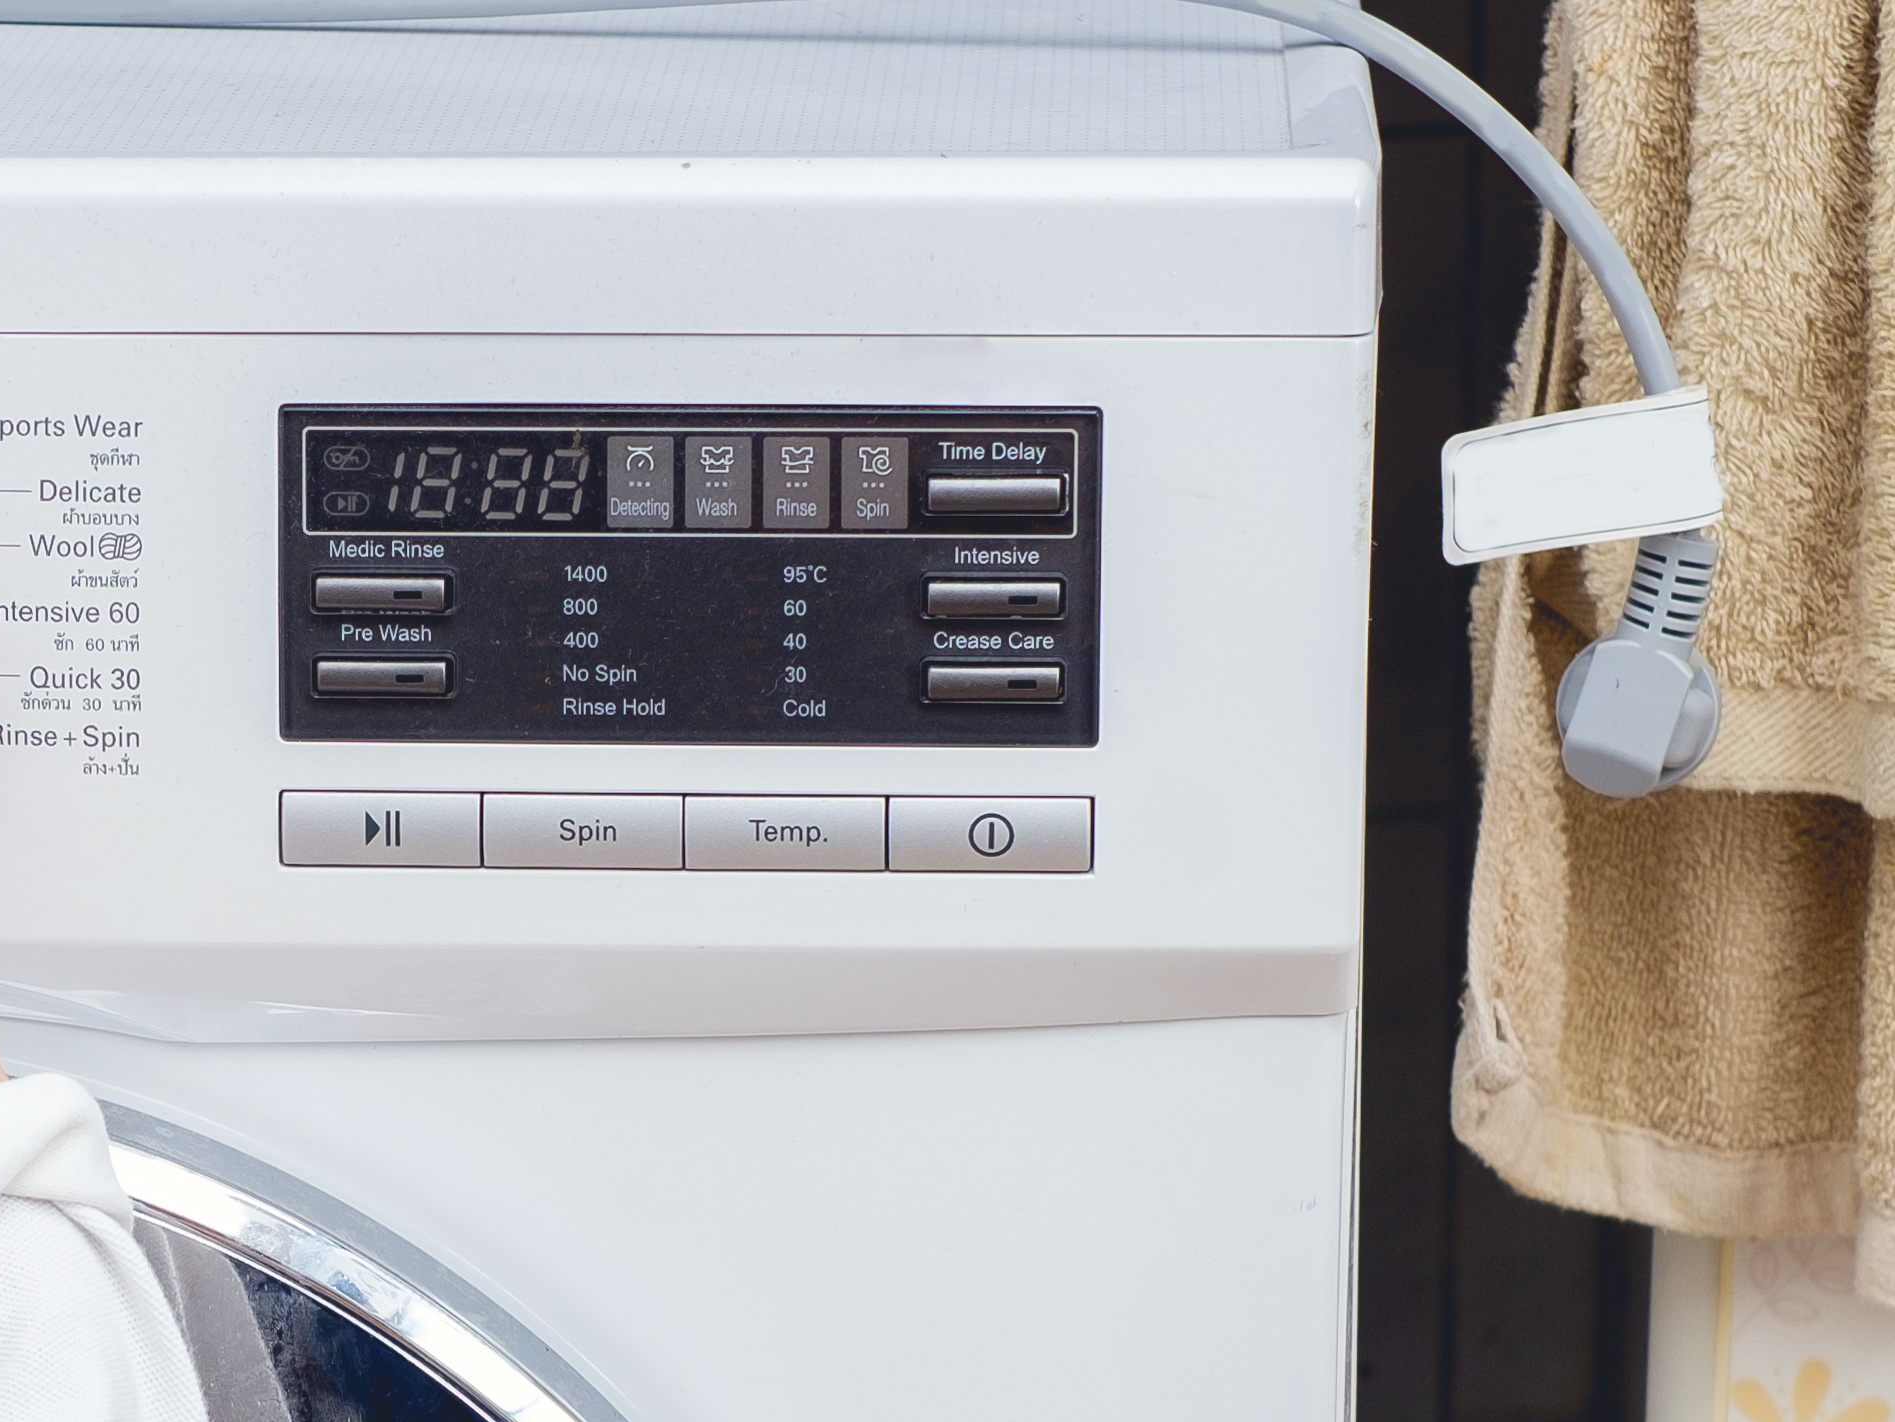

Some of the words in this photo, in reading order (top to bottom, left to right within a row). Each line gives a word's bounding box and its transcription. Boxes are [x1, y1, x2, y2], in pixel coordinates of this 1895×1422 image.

[74, 415, 143, 437] Wear
[90, 448, 139, 471] ชุดกีฬา
[939, 443, 985, 460] Time
[992, 443, 1046, 464] Delay
[40, 480, 141, 503] Delicate
[63, 508, 139, 525] ผ้าบอบบาง
[611, 498, 669, 520] Detecting
[696, 498, 737, 517] Wash
[777, 498, 816, 517] Rinse
[857, 498, 889, 520] Spin
[29, 534, 93, 557] Wool
[330, 540, 384, 557] Medic
[392, 541, 444, 558] Rinse
[955, 547, 1039, 564] Intensive
[72, 568, 139, 588] ผ้าขนสัตว์
[564, 566, 607, 582] 1400
[110, 602, 139, 623] 60
[564, 599, 597, 615] 800
[784, 600, 806, 616] 60
[54, 633, 73, 650] ซัก
[86, 638, 104, 651] 60
[111, 634, 139, 651] นาที
[342, 624, 373, 641] Pre
[379, 625, 431, 641] Wash
[564, 632, 598, 648] 400
[783, 634, 806, 650] 40
[934, 633, 1001, 650] Crease
[1009, 633, 1054, 650] Care
[31, 666, 101, 689] Quick
[111, 668, 140, 690] 30
[563, 665, 589, 681] No
[596, 665, 636, 685] Spin
[785, 667, 806, 682] 30
[21, 692, 71, 710] ซักด่วน
[83, 698, 101, 711] 30
[113, 694, 141, 711] นาที
[564, 699, 616, 715] Rinse
[624, 699, 665, 715] Hold
[783, 700, 825, 717] Cold
[560, 819, 616, 845] Spin
[749, 820, 828, 847] Temp.
